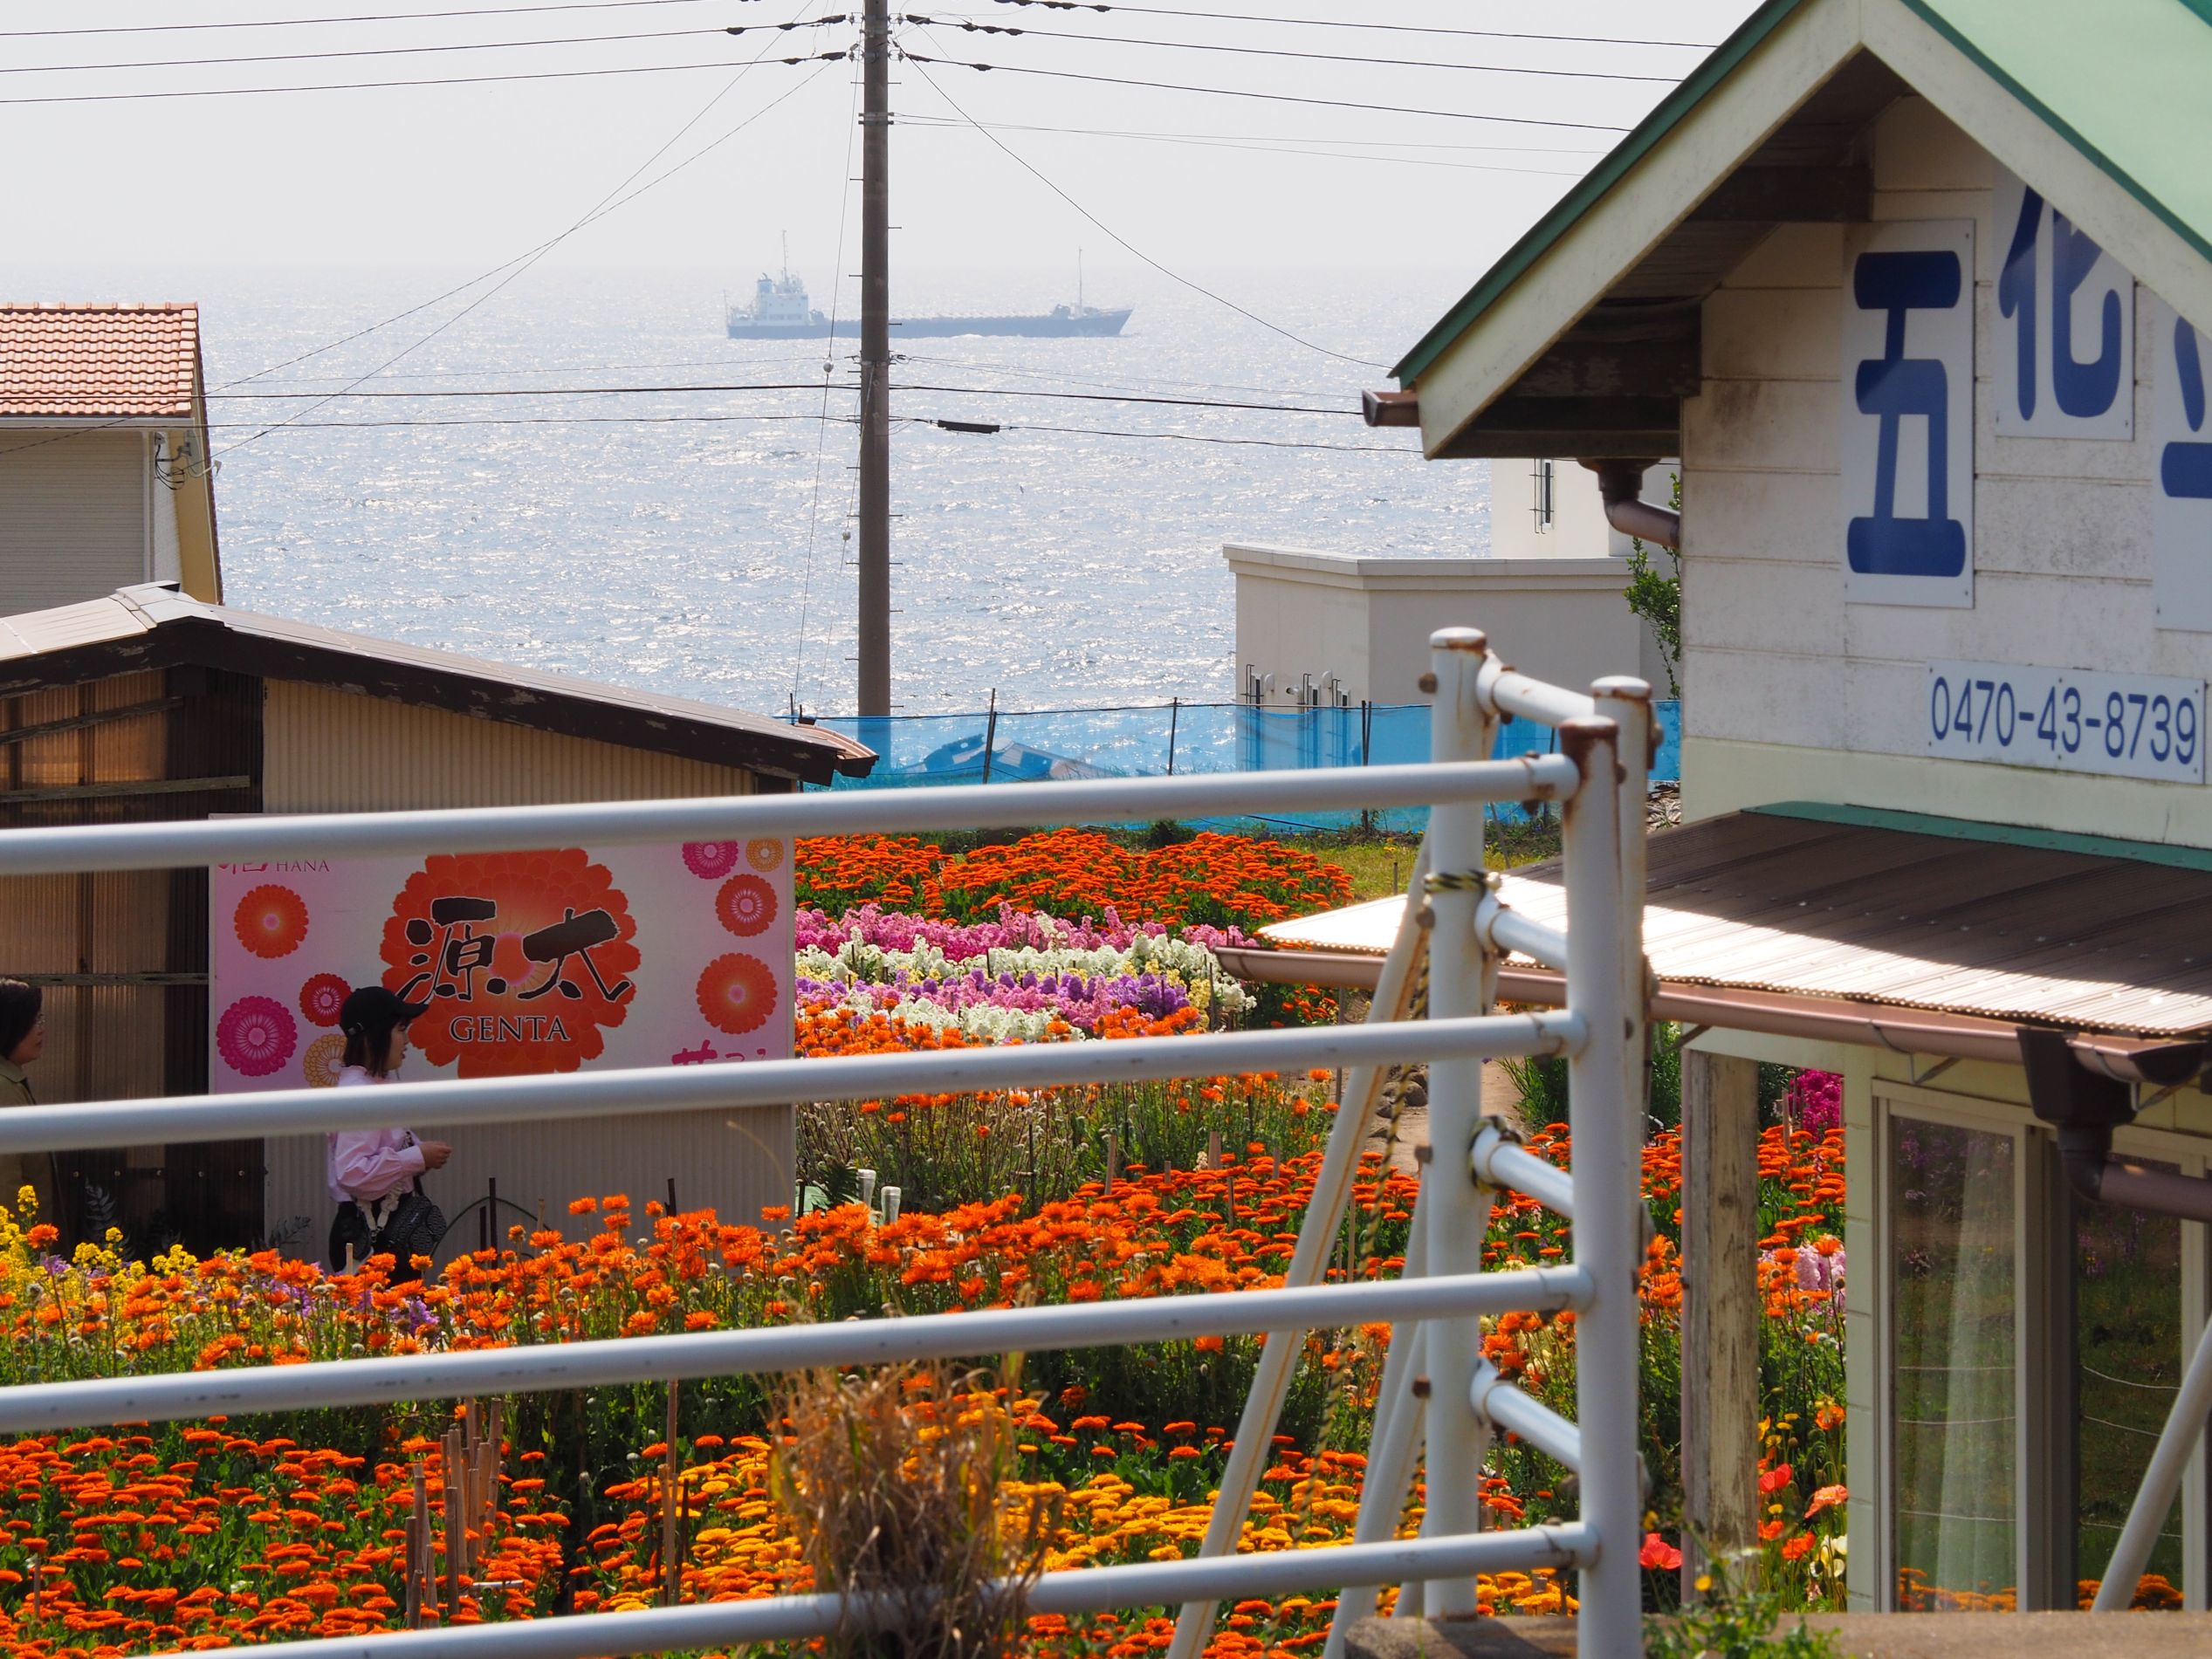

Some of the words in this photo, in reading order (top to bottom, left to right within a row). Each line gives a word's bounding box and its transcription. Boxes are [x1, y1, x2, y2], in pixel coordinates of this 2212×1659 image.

[1931, 676, 2197, 764] 0470-43-8739
[277, 860, 330, 872] HANA
[395, 898, 631, 1001] 源太
[450, 1016, 570, 1042] GENTA
